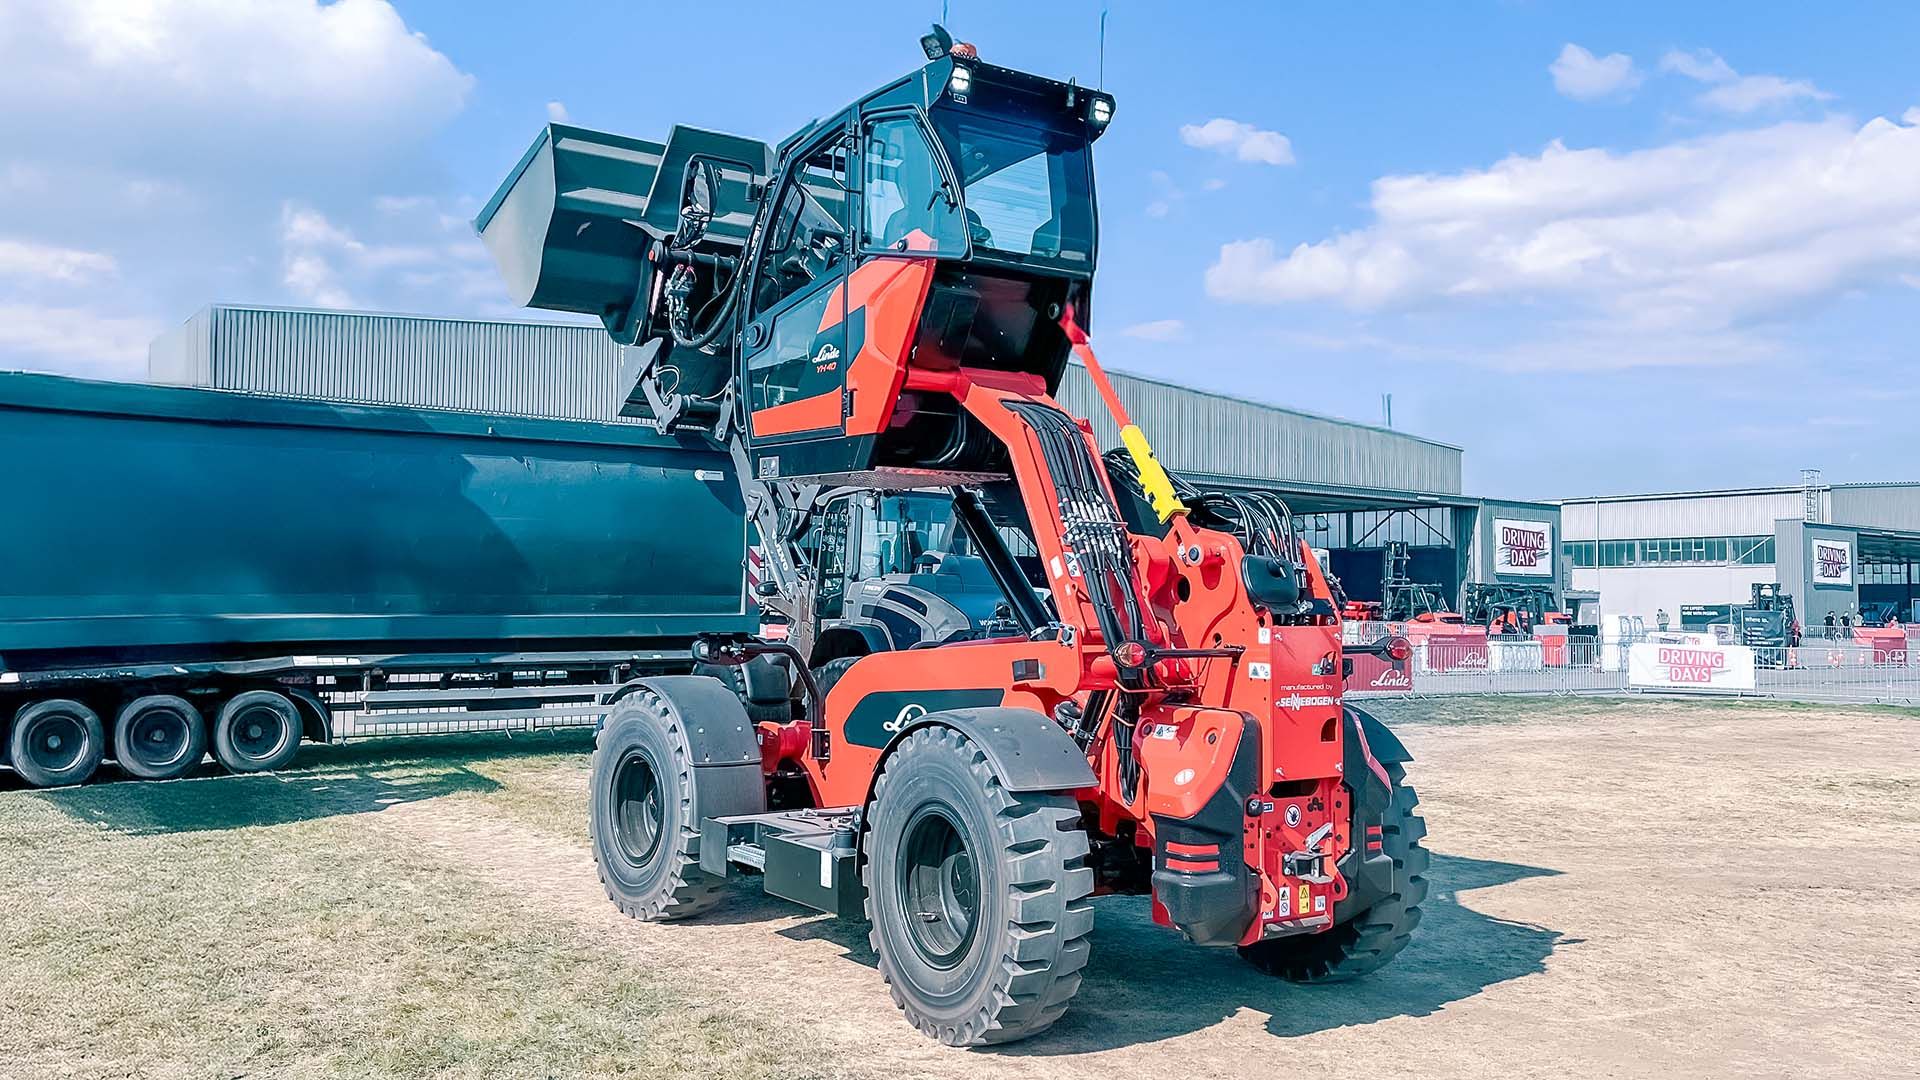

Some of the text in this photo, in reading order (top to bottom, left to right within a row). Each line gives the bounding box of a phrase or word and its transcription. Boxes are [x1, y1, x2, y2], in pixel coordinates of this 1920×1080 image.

[812, 344, 840, 363] Linde
[1503, 528, 1544, 550] DRIVING
[1511, 549, 1536, 566] DAYS
[1818, 546, 1846, 564] DRIVING
[1823, 563, 1841, 577] DAYS
[1661, 649, 1722, 667] DRIVING
[1370, 668, 1409, 687] Linde
[1672, 667, 1709, 681] DAYS
[1325, 683, 1334, 691] by
